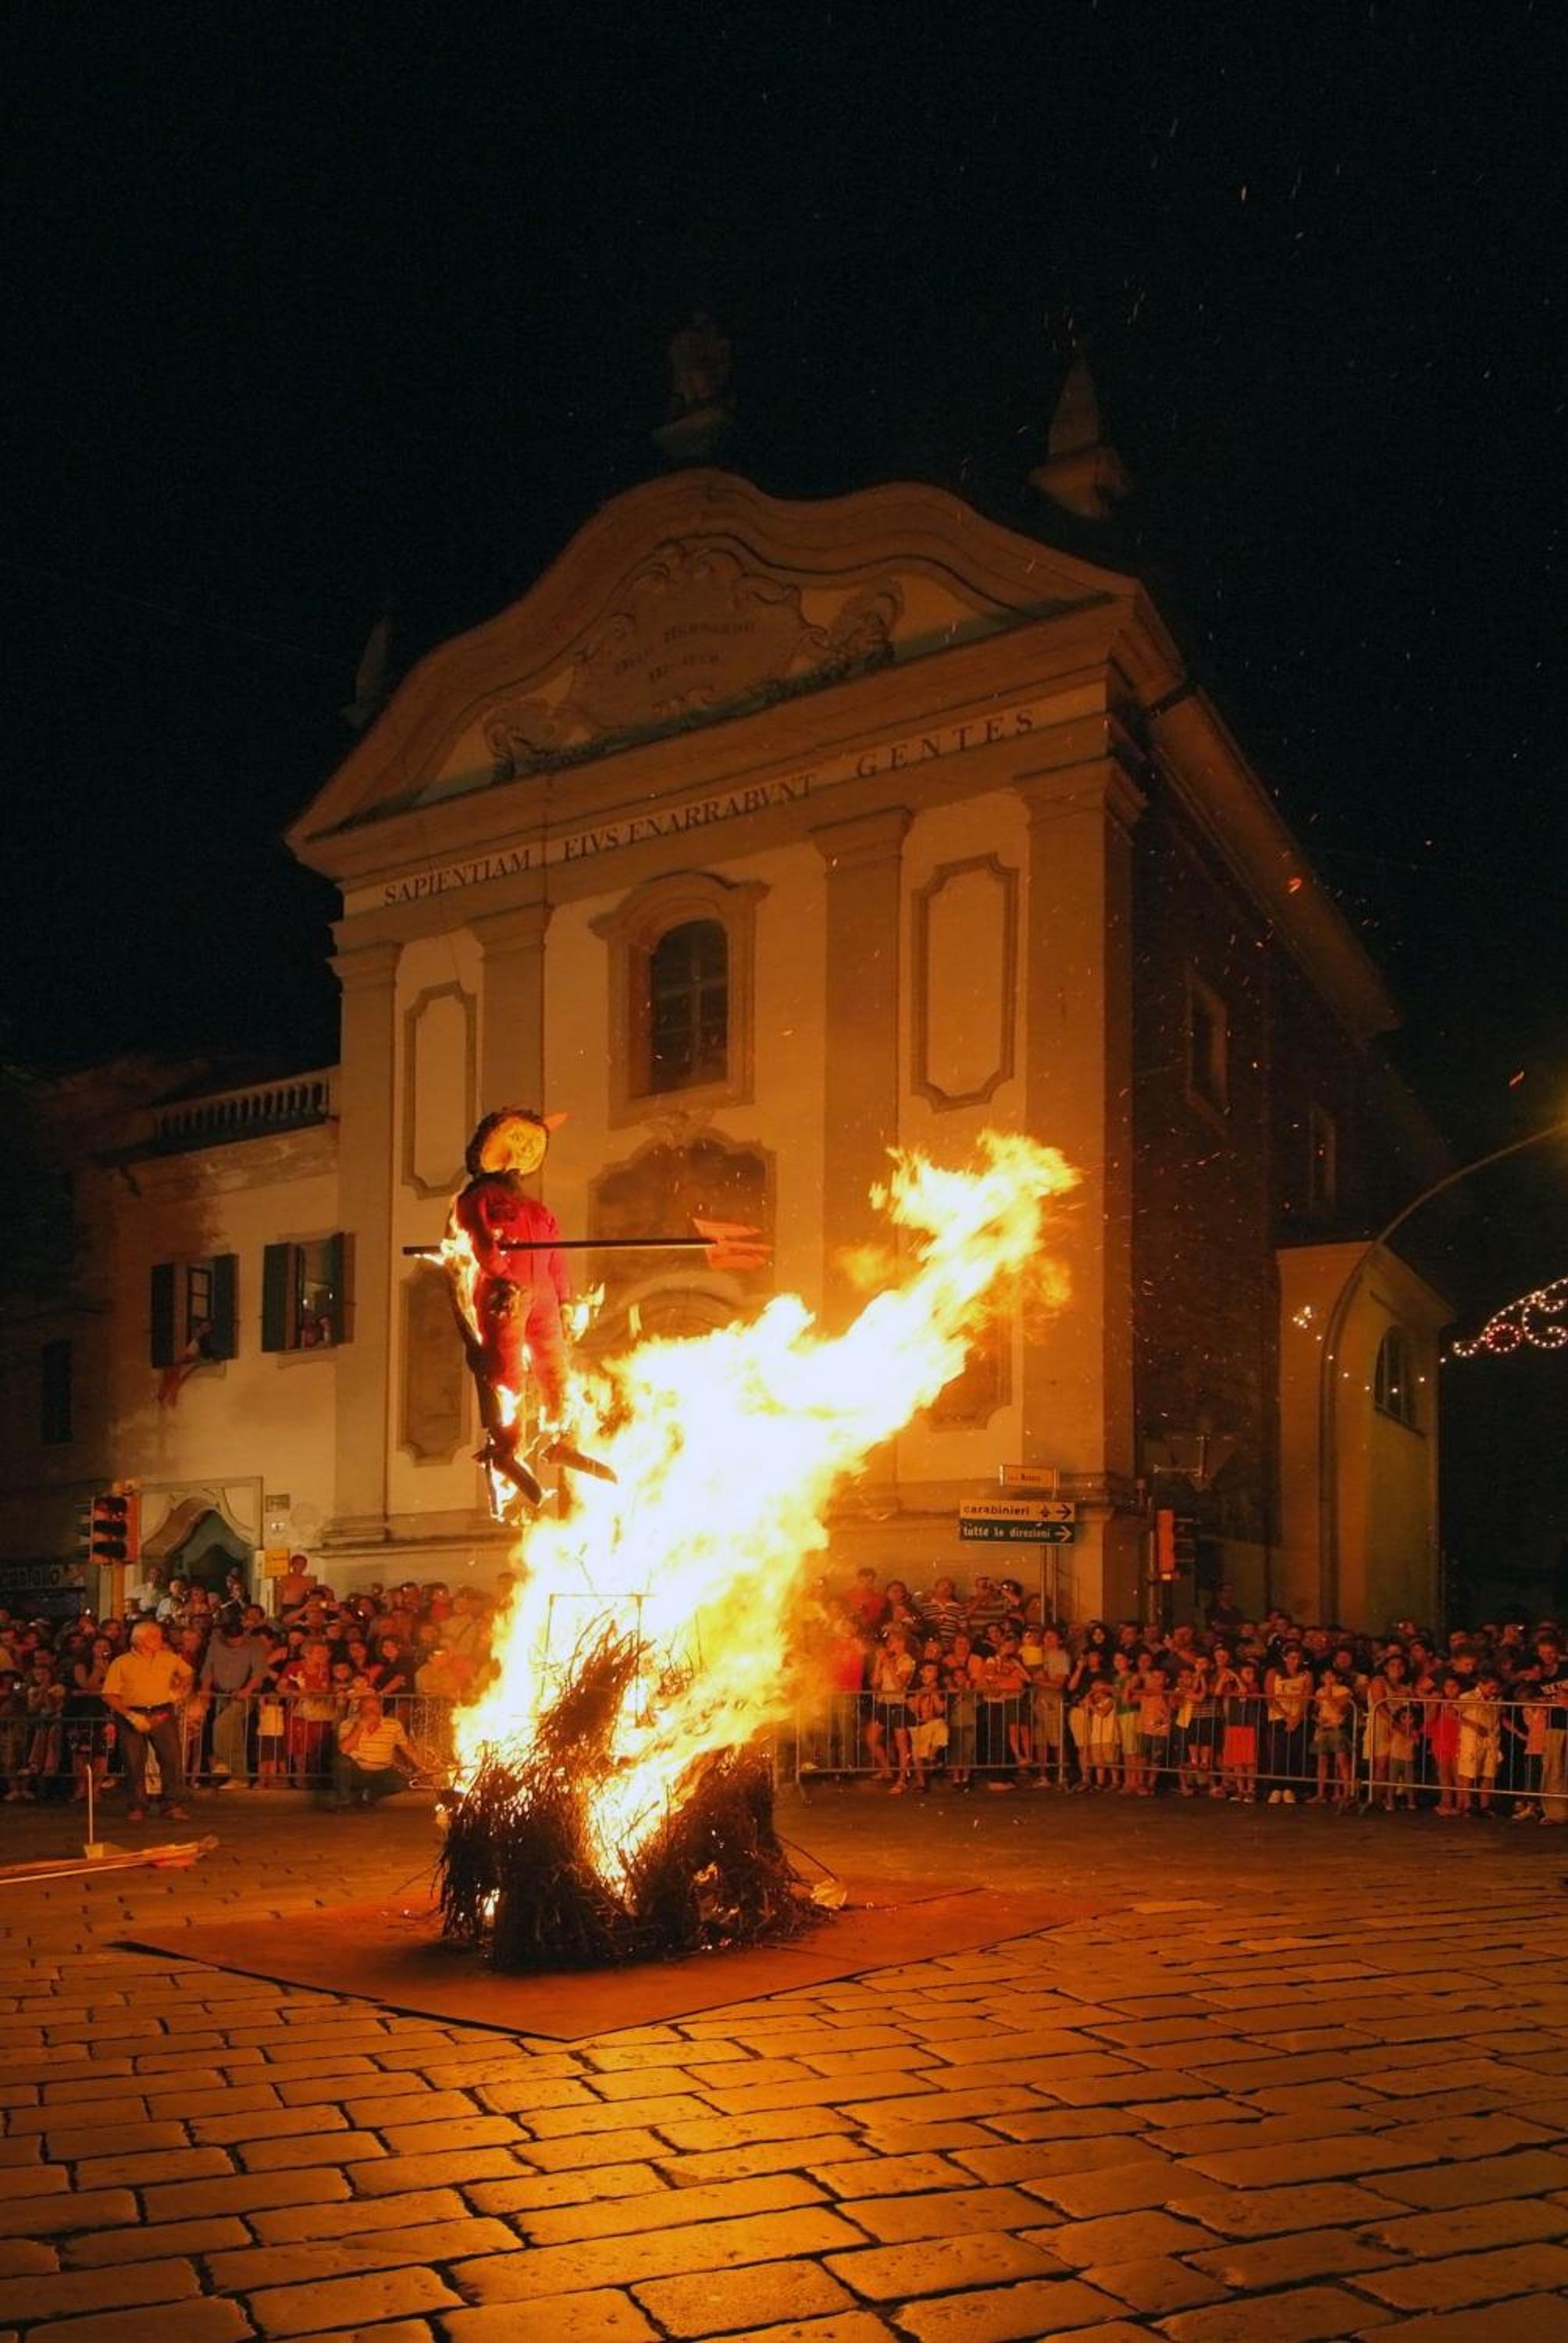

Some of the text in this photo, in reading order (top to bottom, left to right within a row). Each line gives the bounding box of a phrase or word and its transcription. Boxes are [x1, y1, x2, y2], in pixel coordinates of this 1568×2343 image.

[385, 710, 1033, 906] SAPIENTIAM EIVS ENARRABVNT GENTES
[964, 1505, 1030, 1516] carabinieri
[964, 1526, 1050, 1538] tutte le direzioni
